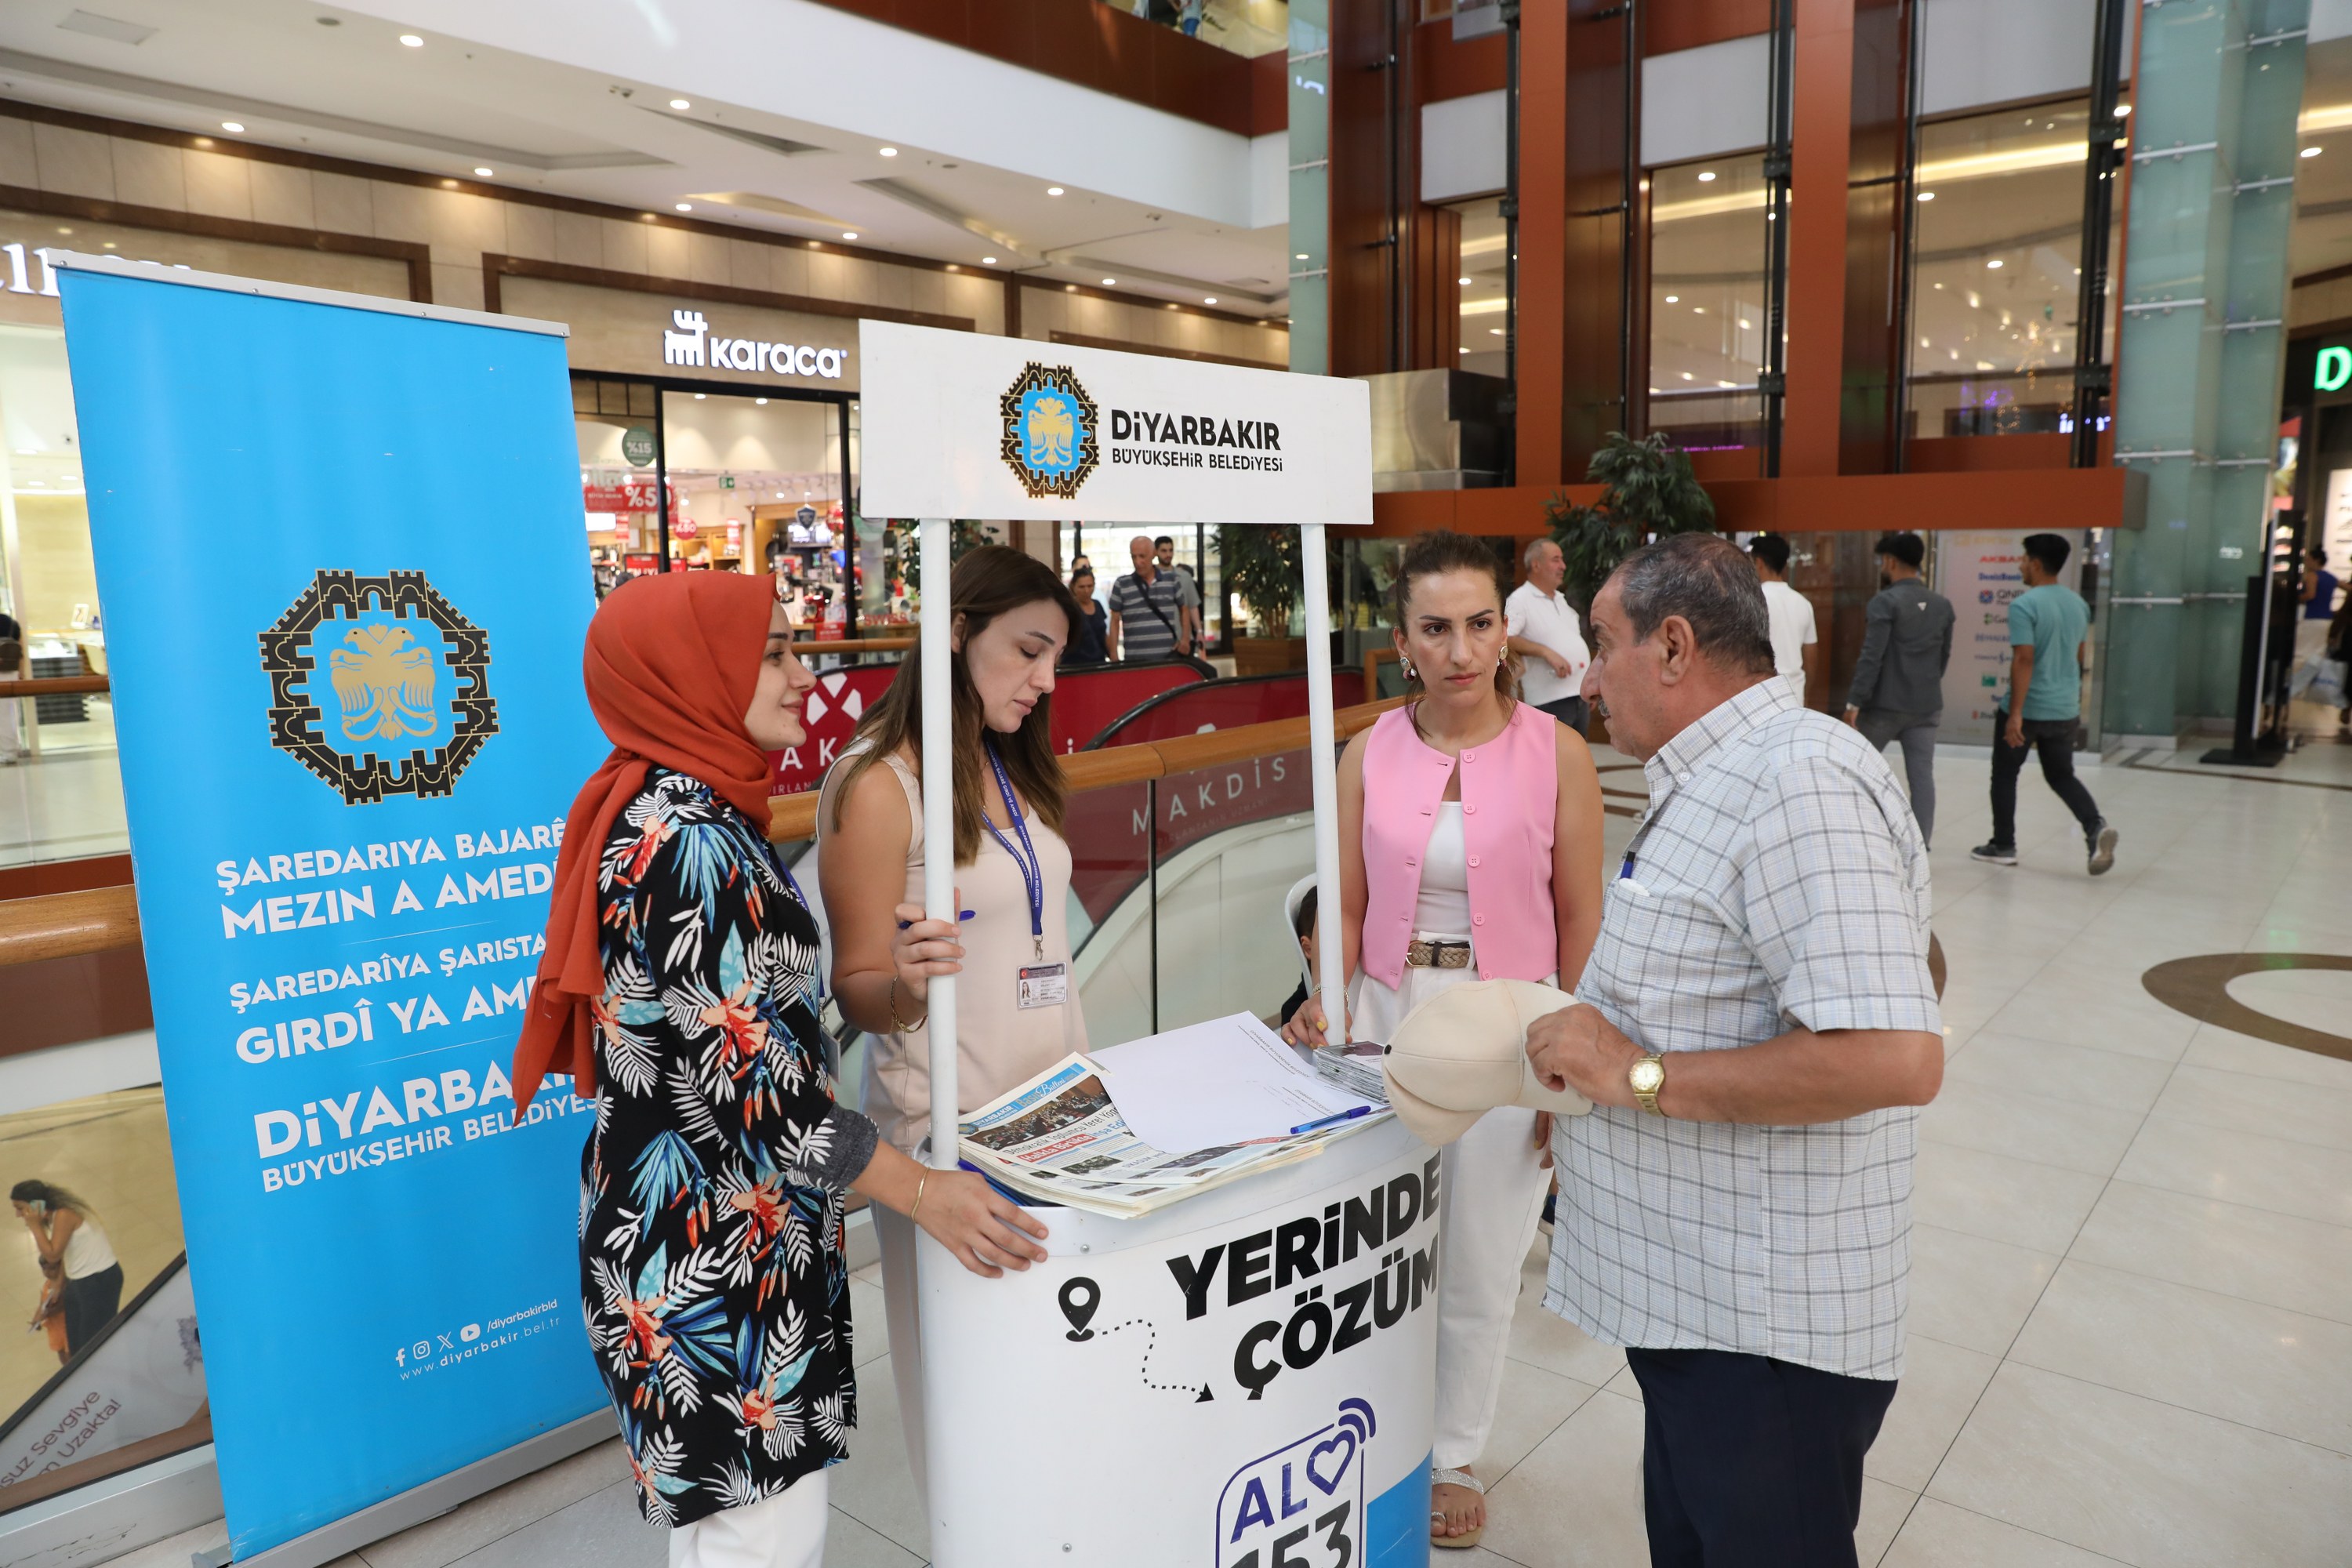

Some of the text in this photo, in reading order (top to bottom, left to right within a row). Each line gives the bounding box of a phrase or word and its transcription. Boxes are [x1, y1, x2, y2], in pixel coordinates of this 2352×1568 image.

[710, 337, 842, 379] karaca
[216, 837, 446, 896] ŞAREDARIYA
[221, 857, 558, 938] MEZIN A AMED
[229, 953, 431, 1014] ŞAREDARÎYA
[236, 975, 537, 1064] GIRDÎ YA AM
[487, 1298, 557, 1333] /diyarbakirbld
[1233, 1232, 1439, 1400] ÇÖZÜM
[400, 1316, 560, 1381] www.diyarbakir.bel.tr
[0, 1456, 35, 1488] suz
